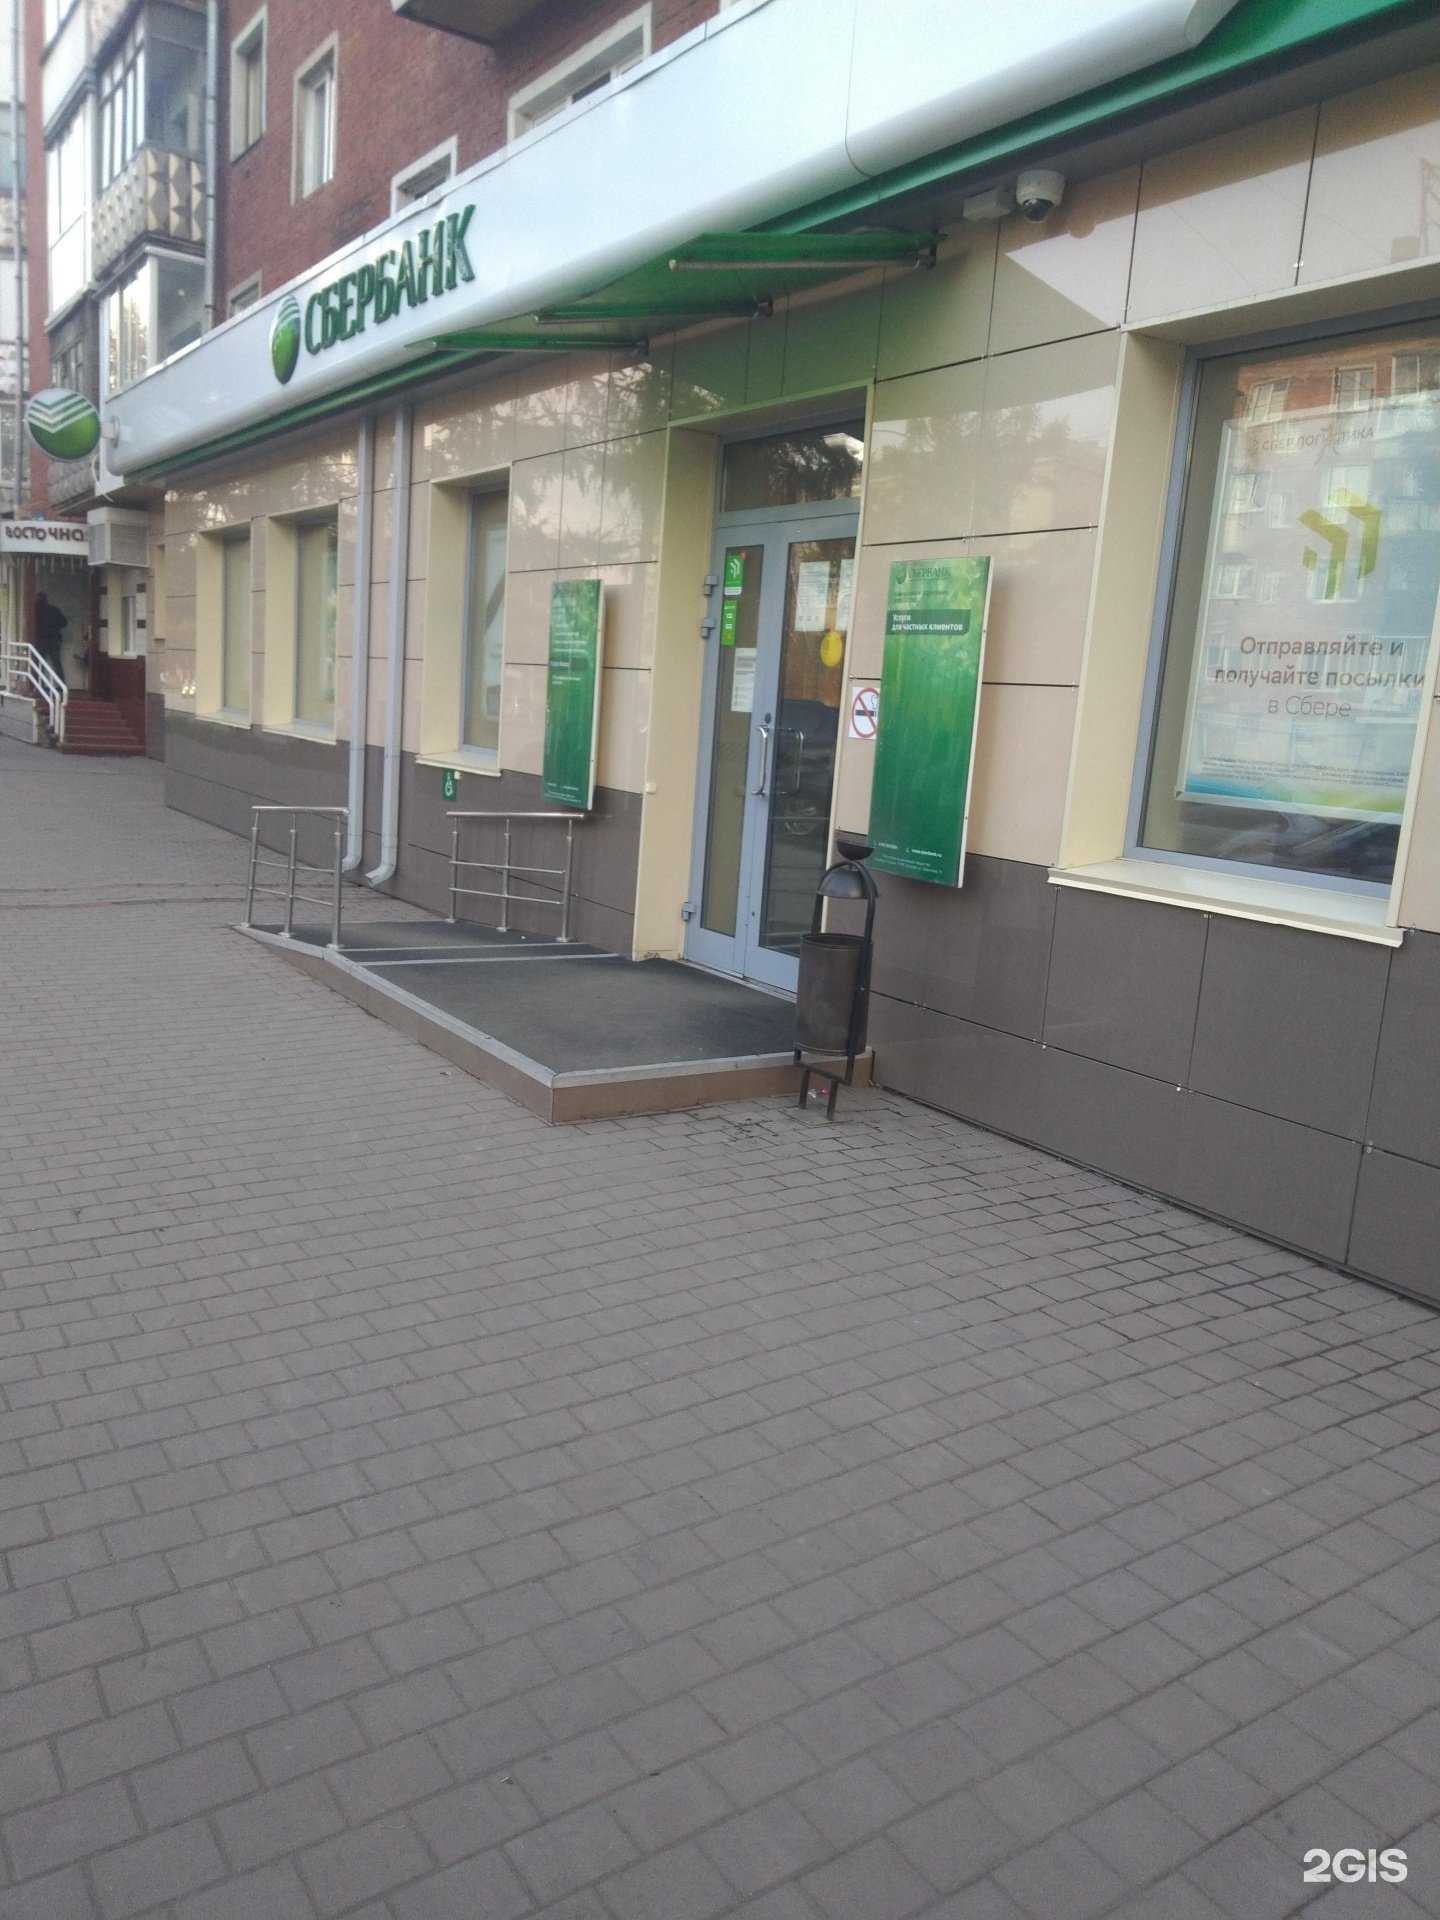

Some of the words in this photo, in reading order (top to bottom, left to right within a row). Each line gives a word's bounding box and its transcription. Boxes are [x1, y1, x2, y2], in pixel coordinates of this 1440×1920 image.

[305, 204, 476, 356] СБЕРБАНК
[1240, 634, 1383, 659] Отправляйте
[1390, 641, 1404, 657] и
[1215, 664, 1319, 688] получайте
[1326, 671, 1425, 688] посылки
[1268, 699, 1279, 714] в
[1285, 694, 1351, 719] Сбере
